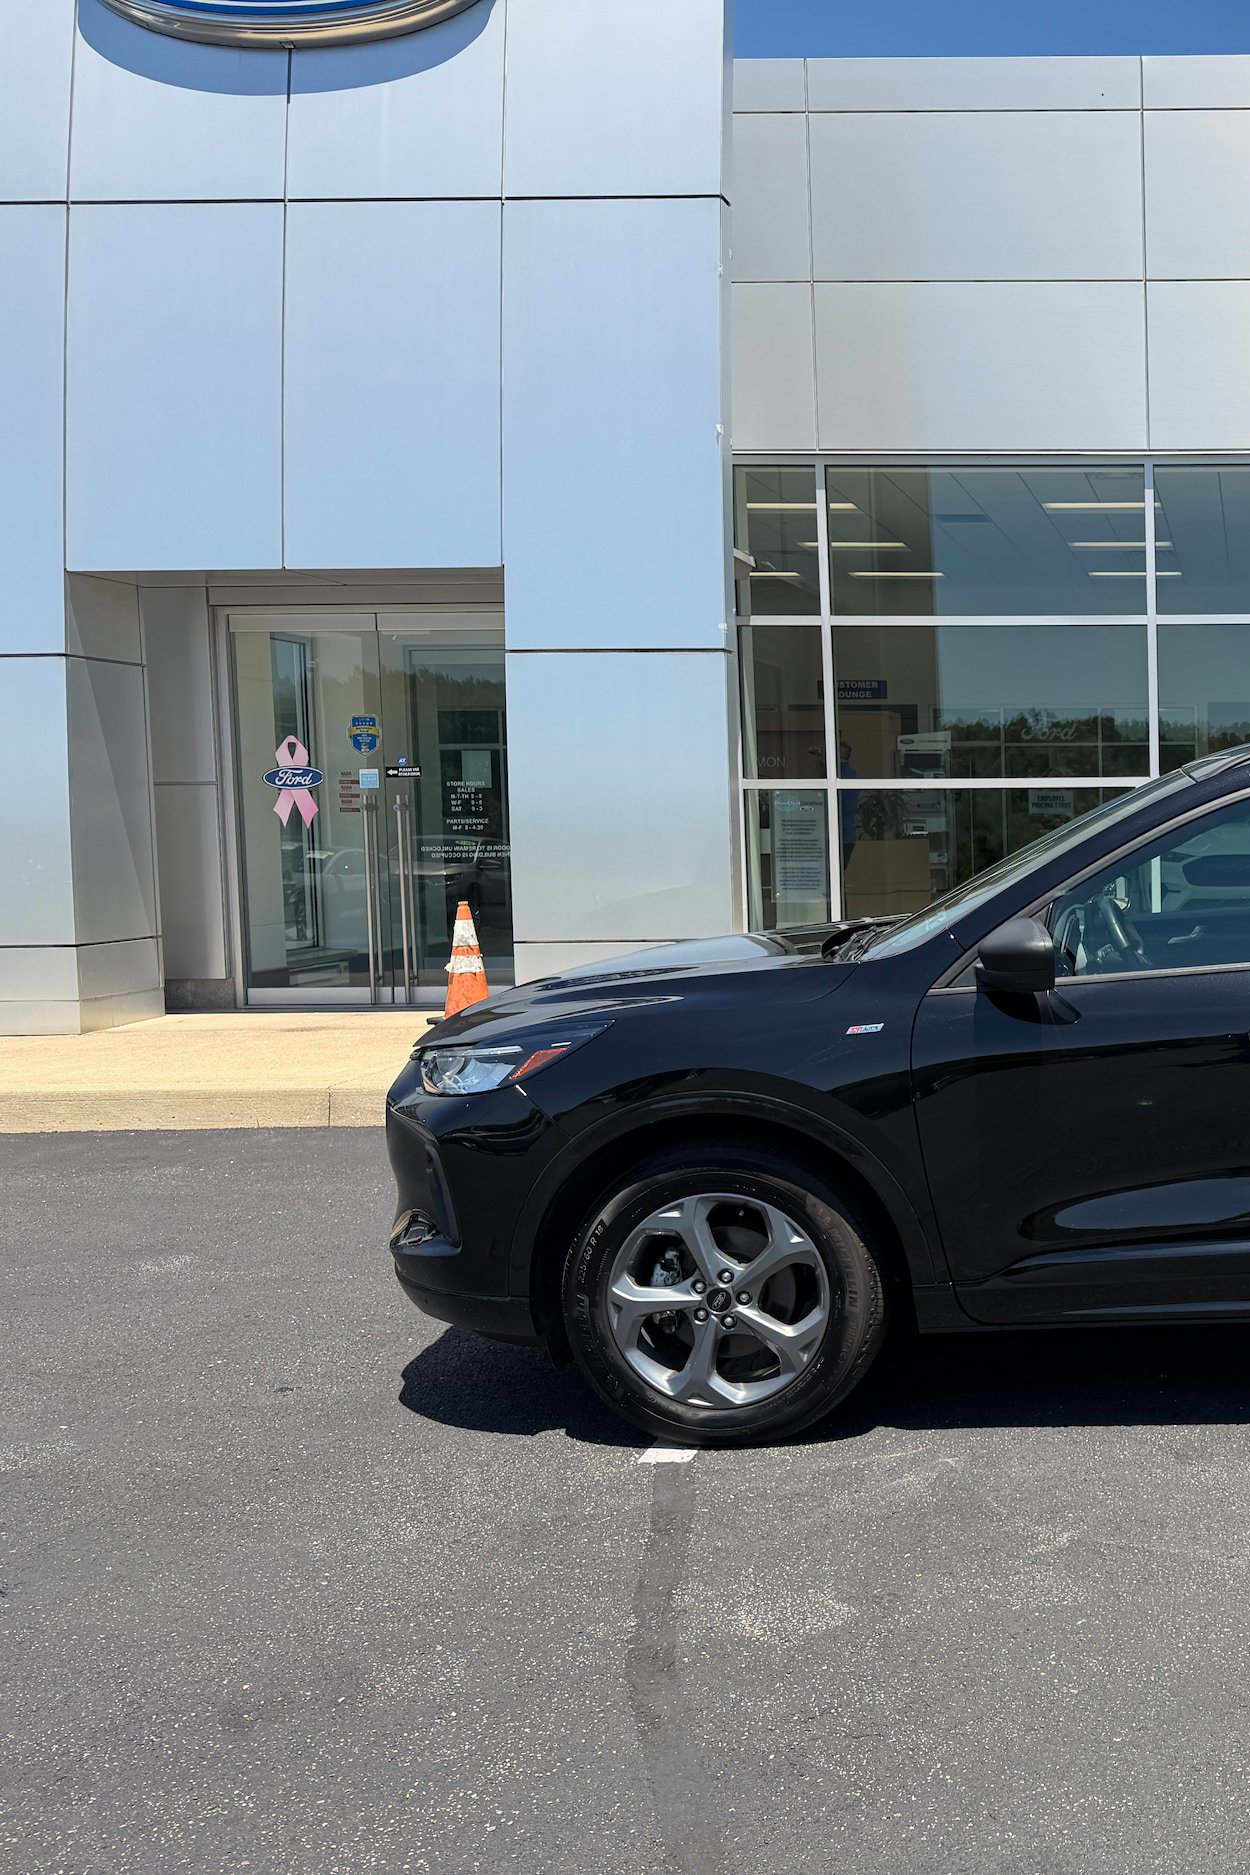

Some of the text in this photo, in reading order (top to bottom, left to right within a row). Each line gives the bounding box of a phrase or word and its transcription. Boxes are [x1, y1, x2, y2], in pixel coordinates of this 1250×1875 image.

[838, 681, 879, 689] STOMER
[758, 755, 786, 768] MON
[275, 769, 313, 786] Ford
